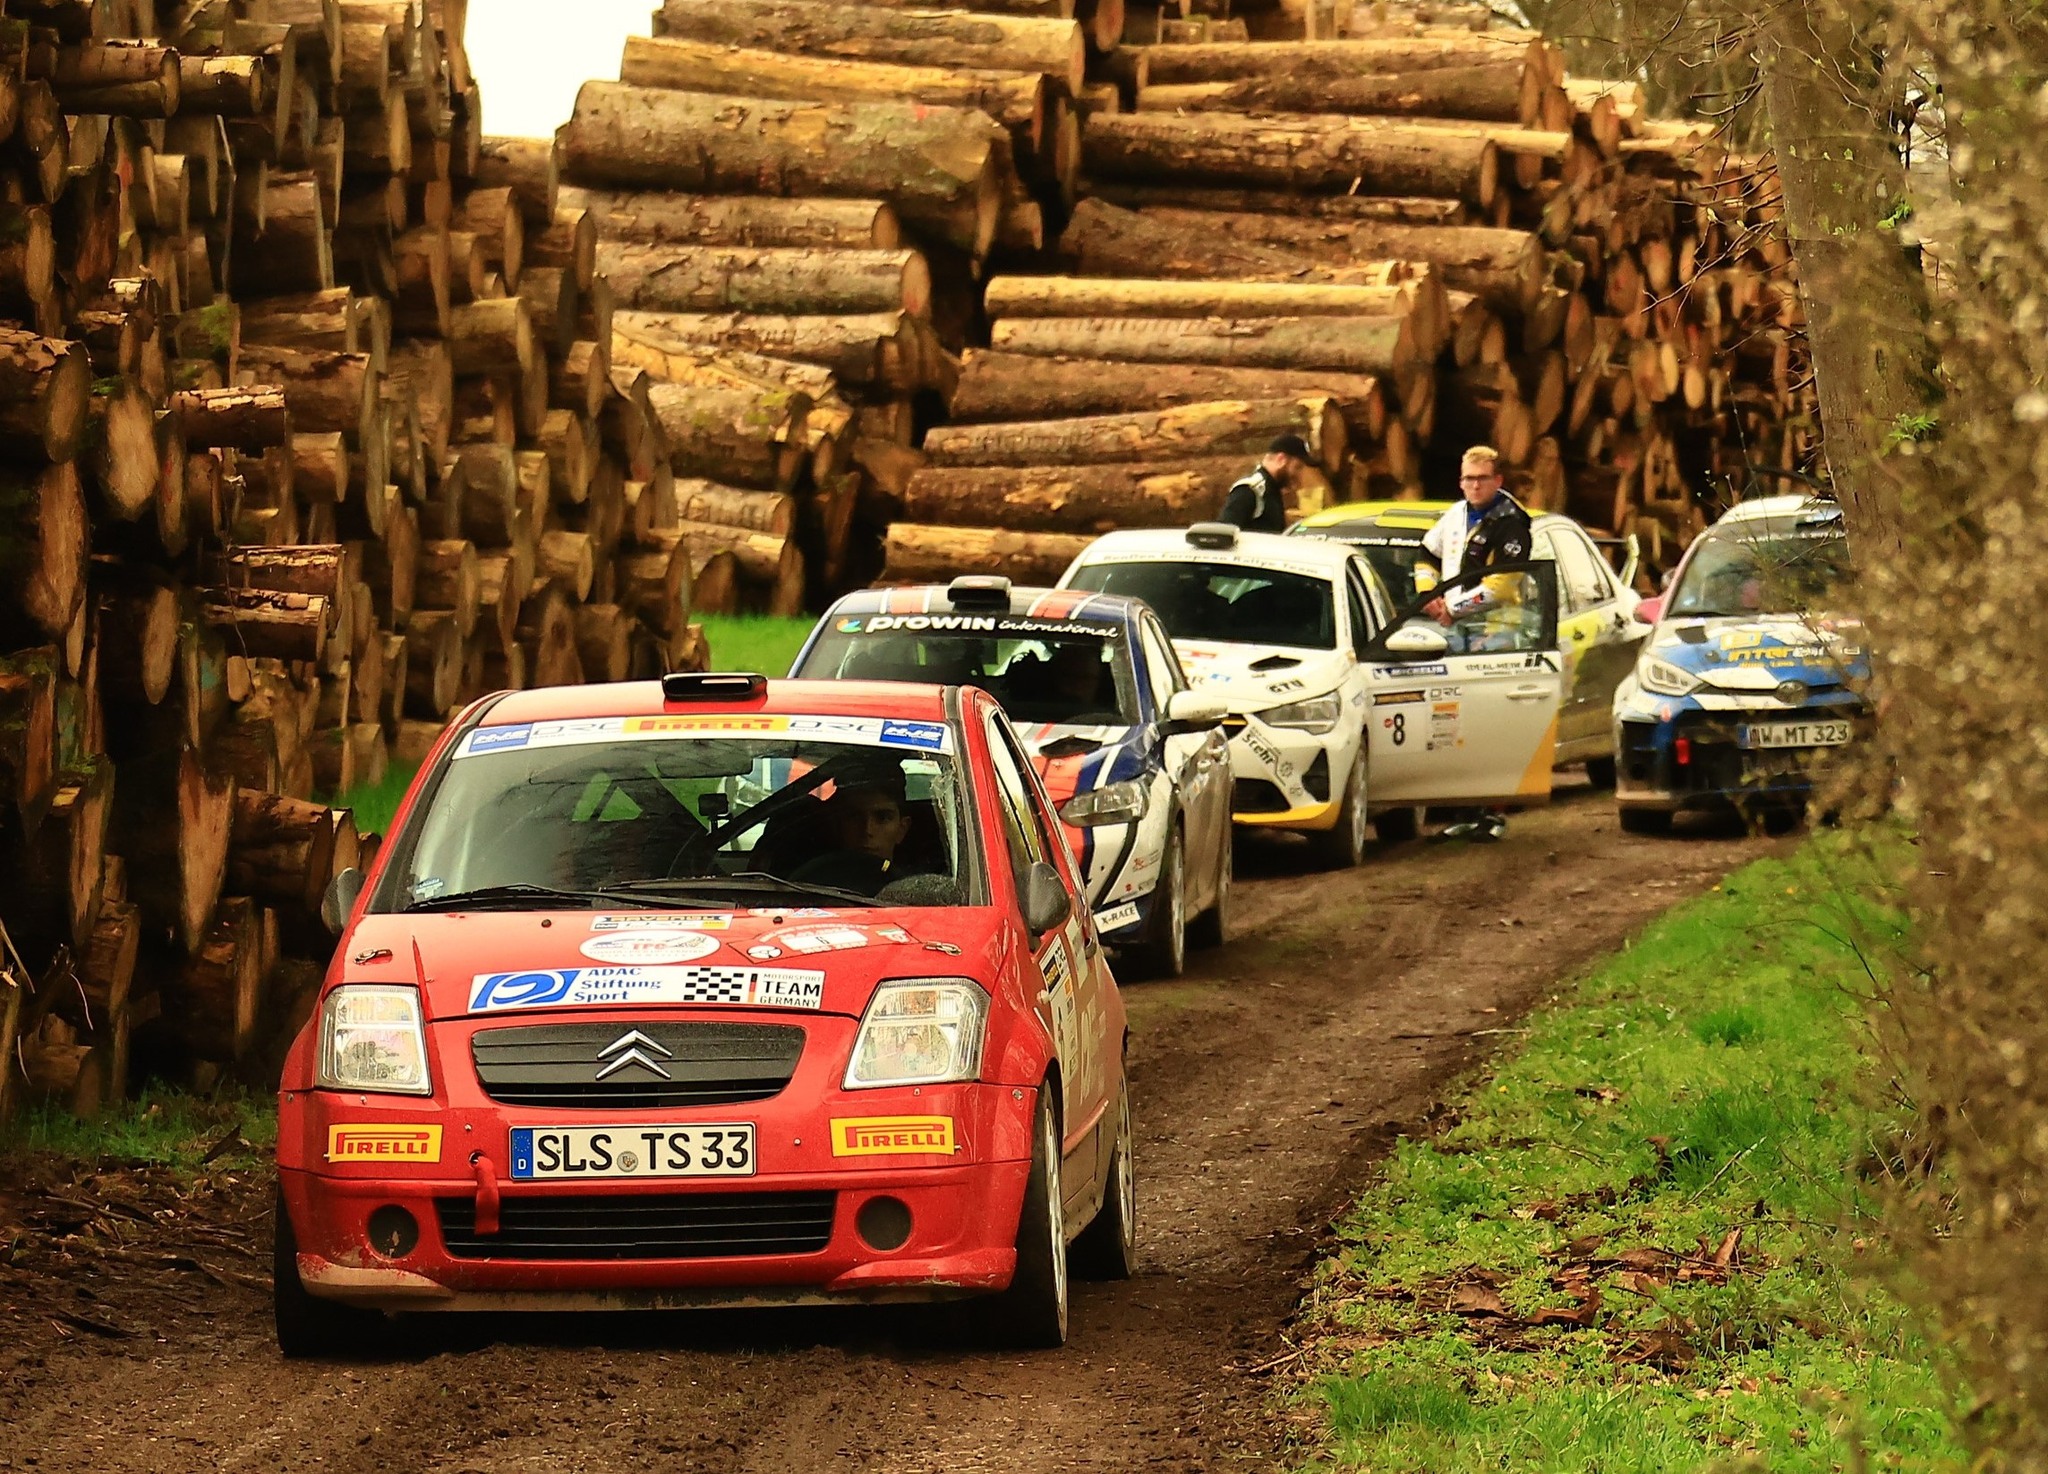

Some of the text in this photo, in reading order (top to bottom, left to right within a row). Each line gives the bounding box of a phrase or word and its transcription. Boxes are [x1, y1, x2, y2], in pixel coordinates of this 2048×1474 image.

[998, 620, 1118, 637] international
[1393, 713, 1405, 746] 8
[1785, 726, 1808, 744] MT
[1101, 906, 1135, 925] X-RACE
[587, 968, 642, 977] ADAC
[763, 973, 821, 982] MOTORSPORT
[580, 979, 662, 989] Stiftung
[763, 980, 821, 997] TEAM
[574, 991, 628, 1003] Sport
[760, 995, 818, 1007] GERMANY
[336, 1132, 429, 1155] PIRELLI
[845, 1124, 945, 1148] PIRELLI
[517, 1131, 749, 1171] D SLS TS 33
